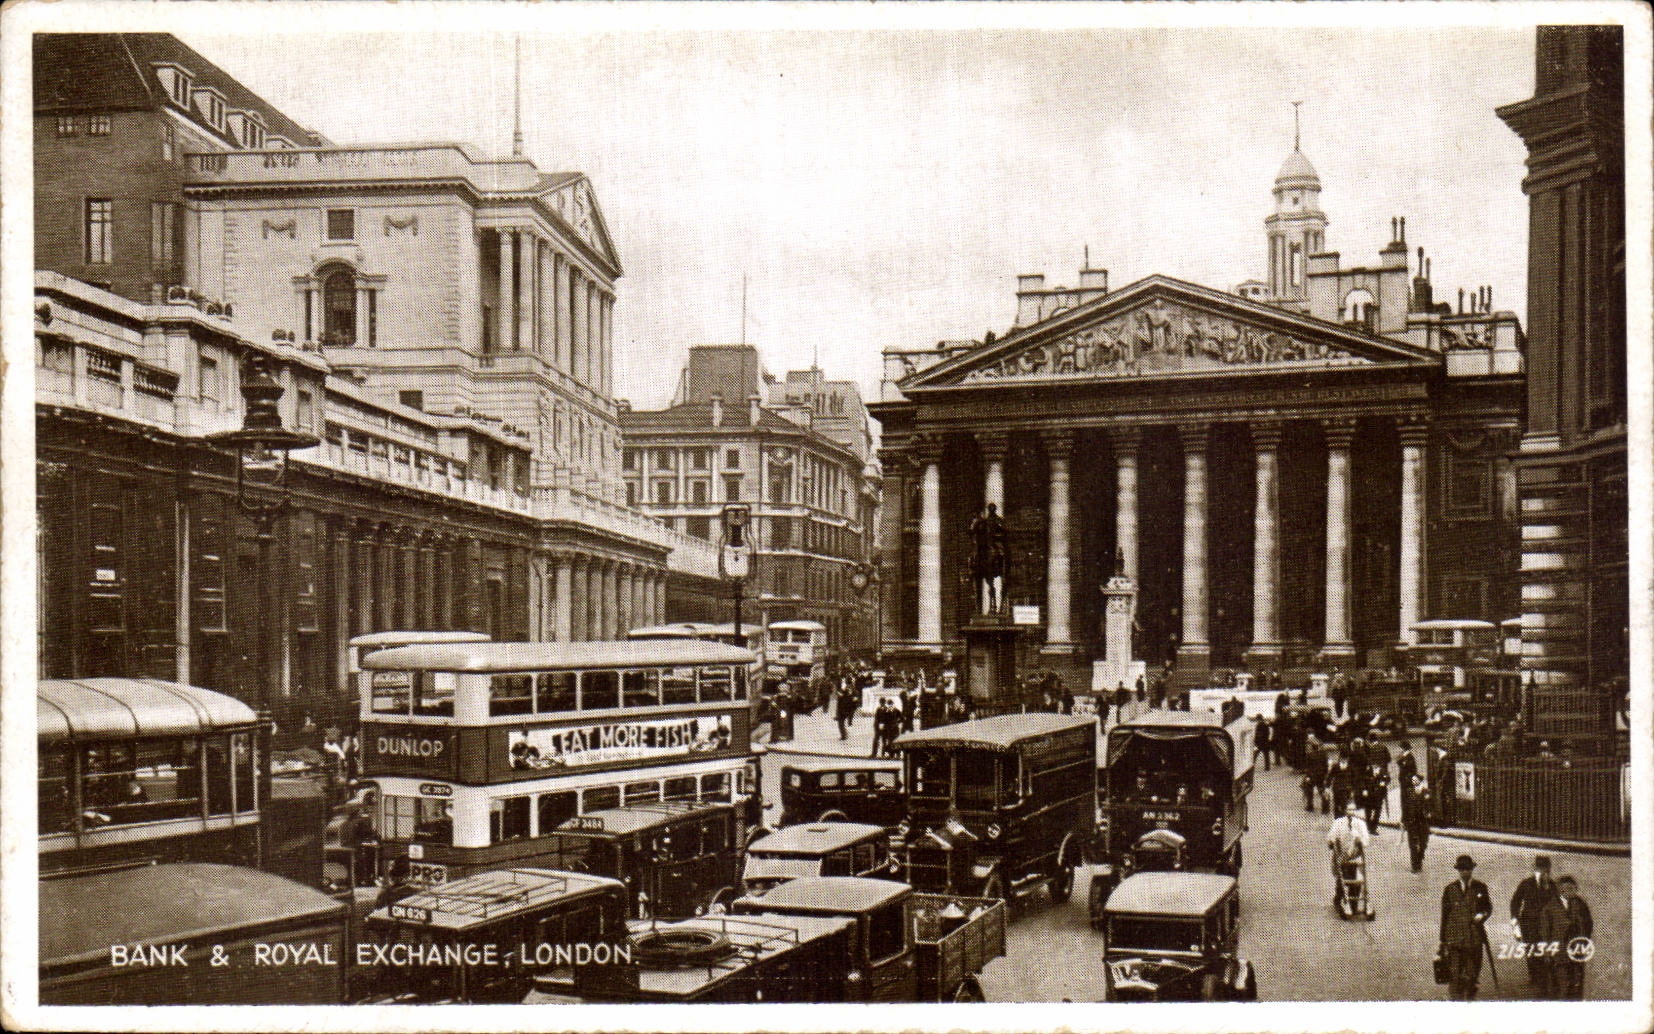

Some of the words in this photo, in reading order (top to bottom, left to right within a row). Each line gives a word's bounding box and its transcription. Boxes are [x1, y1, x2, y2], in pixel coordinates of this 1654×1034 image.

[377, 737, 444, 758] DUNLOP
[560, 729, 594, 754] EAT
[600, 724, 647, 749] MORE
[655, 722, 692, 748] FISH
